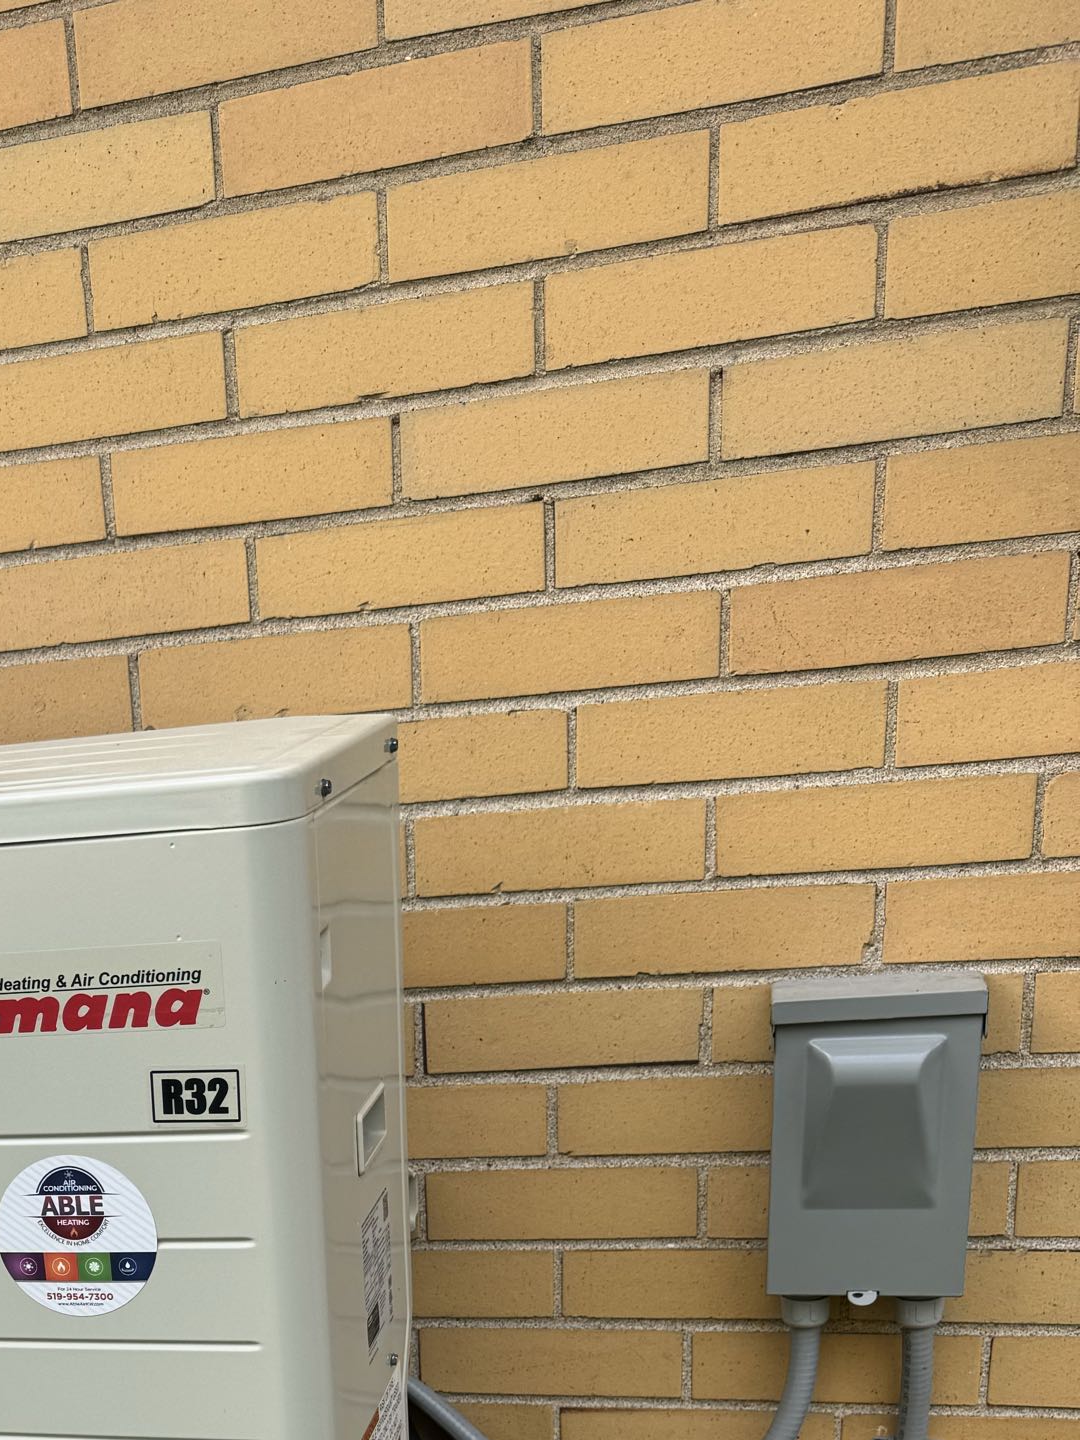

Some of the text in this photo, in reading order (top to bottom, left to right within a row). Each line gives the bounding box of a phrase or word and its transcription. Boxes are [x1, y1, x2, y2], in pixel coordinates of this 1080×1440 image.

[55, 975, 67, 988] &
[71, 973, 94, 987] Air
[98, 967, 202, 985] Conditioning
[161, 1077, 229, 1115] R32
[41, 1195, 105, 1216] ABLE
[37, 1219, 65, 1245] EXCELLENCE
[90, 1218, 110, 1242] COMFORT
[46, 1292, 114, 1300] 519-954-7300
